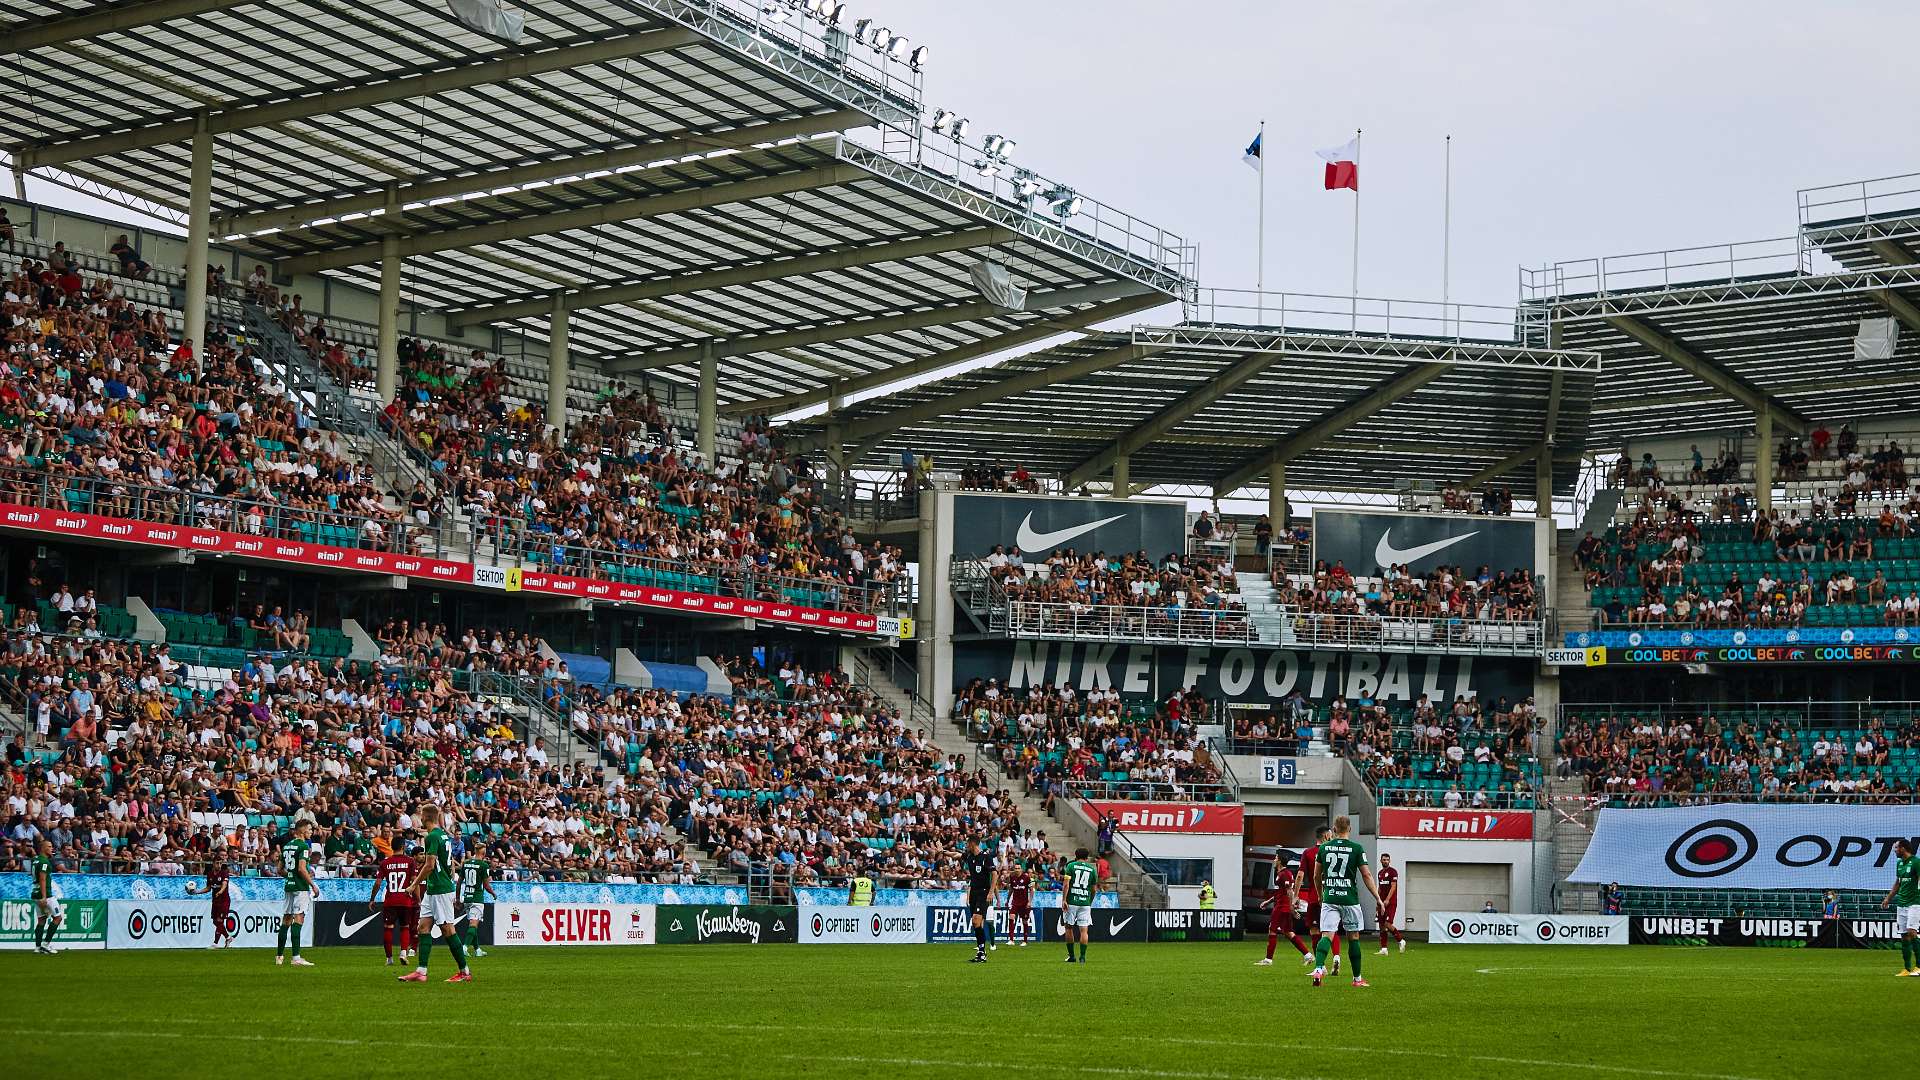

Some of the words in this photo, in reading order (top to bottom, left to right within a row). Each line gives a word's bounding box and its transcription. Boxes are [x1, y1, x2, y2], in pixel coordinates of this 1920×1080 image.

[476, 569, 505, 584] SEKTOR
[510, 575, 517, 586] 4
[903, 622, 908, 634] 5
[1548, 651, 1584, 662] SEKTOR
[1592, 650, 1600, 662] 6
[1625, 650, 1692, 661] COOLBET
[1719, 648, 1784, 660] COOLBET
[1815, 647, 1880, 660] COOLBET
[1009, 640, 1154, 692] NIKE
[1183, 646, 1477, 702] FOOTBALL
[1264, 767, 1275, 781] B
[1121, 809, 1185, 827] Rimi
[1418, 816, 1479, 833] Rimi
[1325, 853, 1349, 878] 27
[389, 871, 406, 892] 82
[464, 868, 477, 886] 10
[1073, 869, 1091, 889] 14
[2, 901, 31, 931] ÜKS
[151, 915, 203, 933] OPTIBET
[244, 916, 280, 933] OPTIB
[884, 917, 915, 932] OPTIBET
[1154, 911, 1193, 928] UNIBET
[1200, 911, 1237, 928] UNIBET
[541, 908, 611, 942] SELVER
[695, 906, 760, 944] Krausberg
[826, 918, 860, 933] OPTIBET
[1469, 923, 1519, 937] OPTIBET
[1559, 925, 1609, 938] OPTIBET
[1643, 918, 1723, 935] UNIBET
[1740, 920, 1822, 937] UNIBET
[506, 930, 525, 939] SELVER
[627, 930, 644, 939] SELVER
